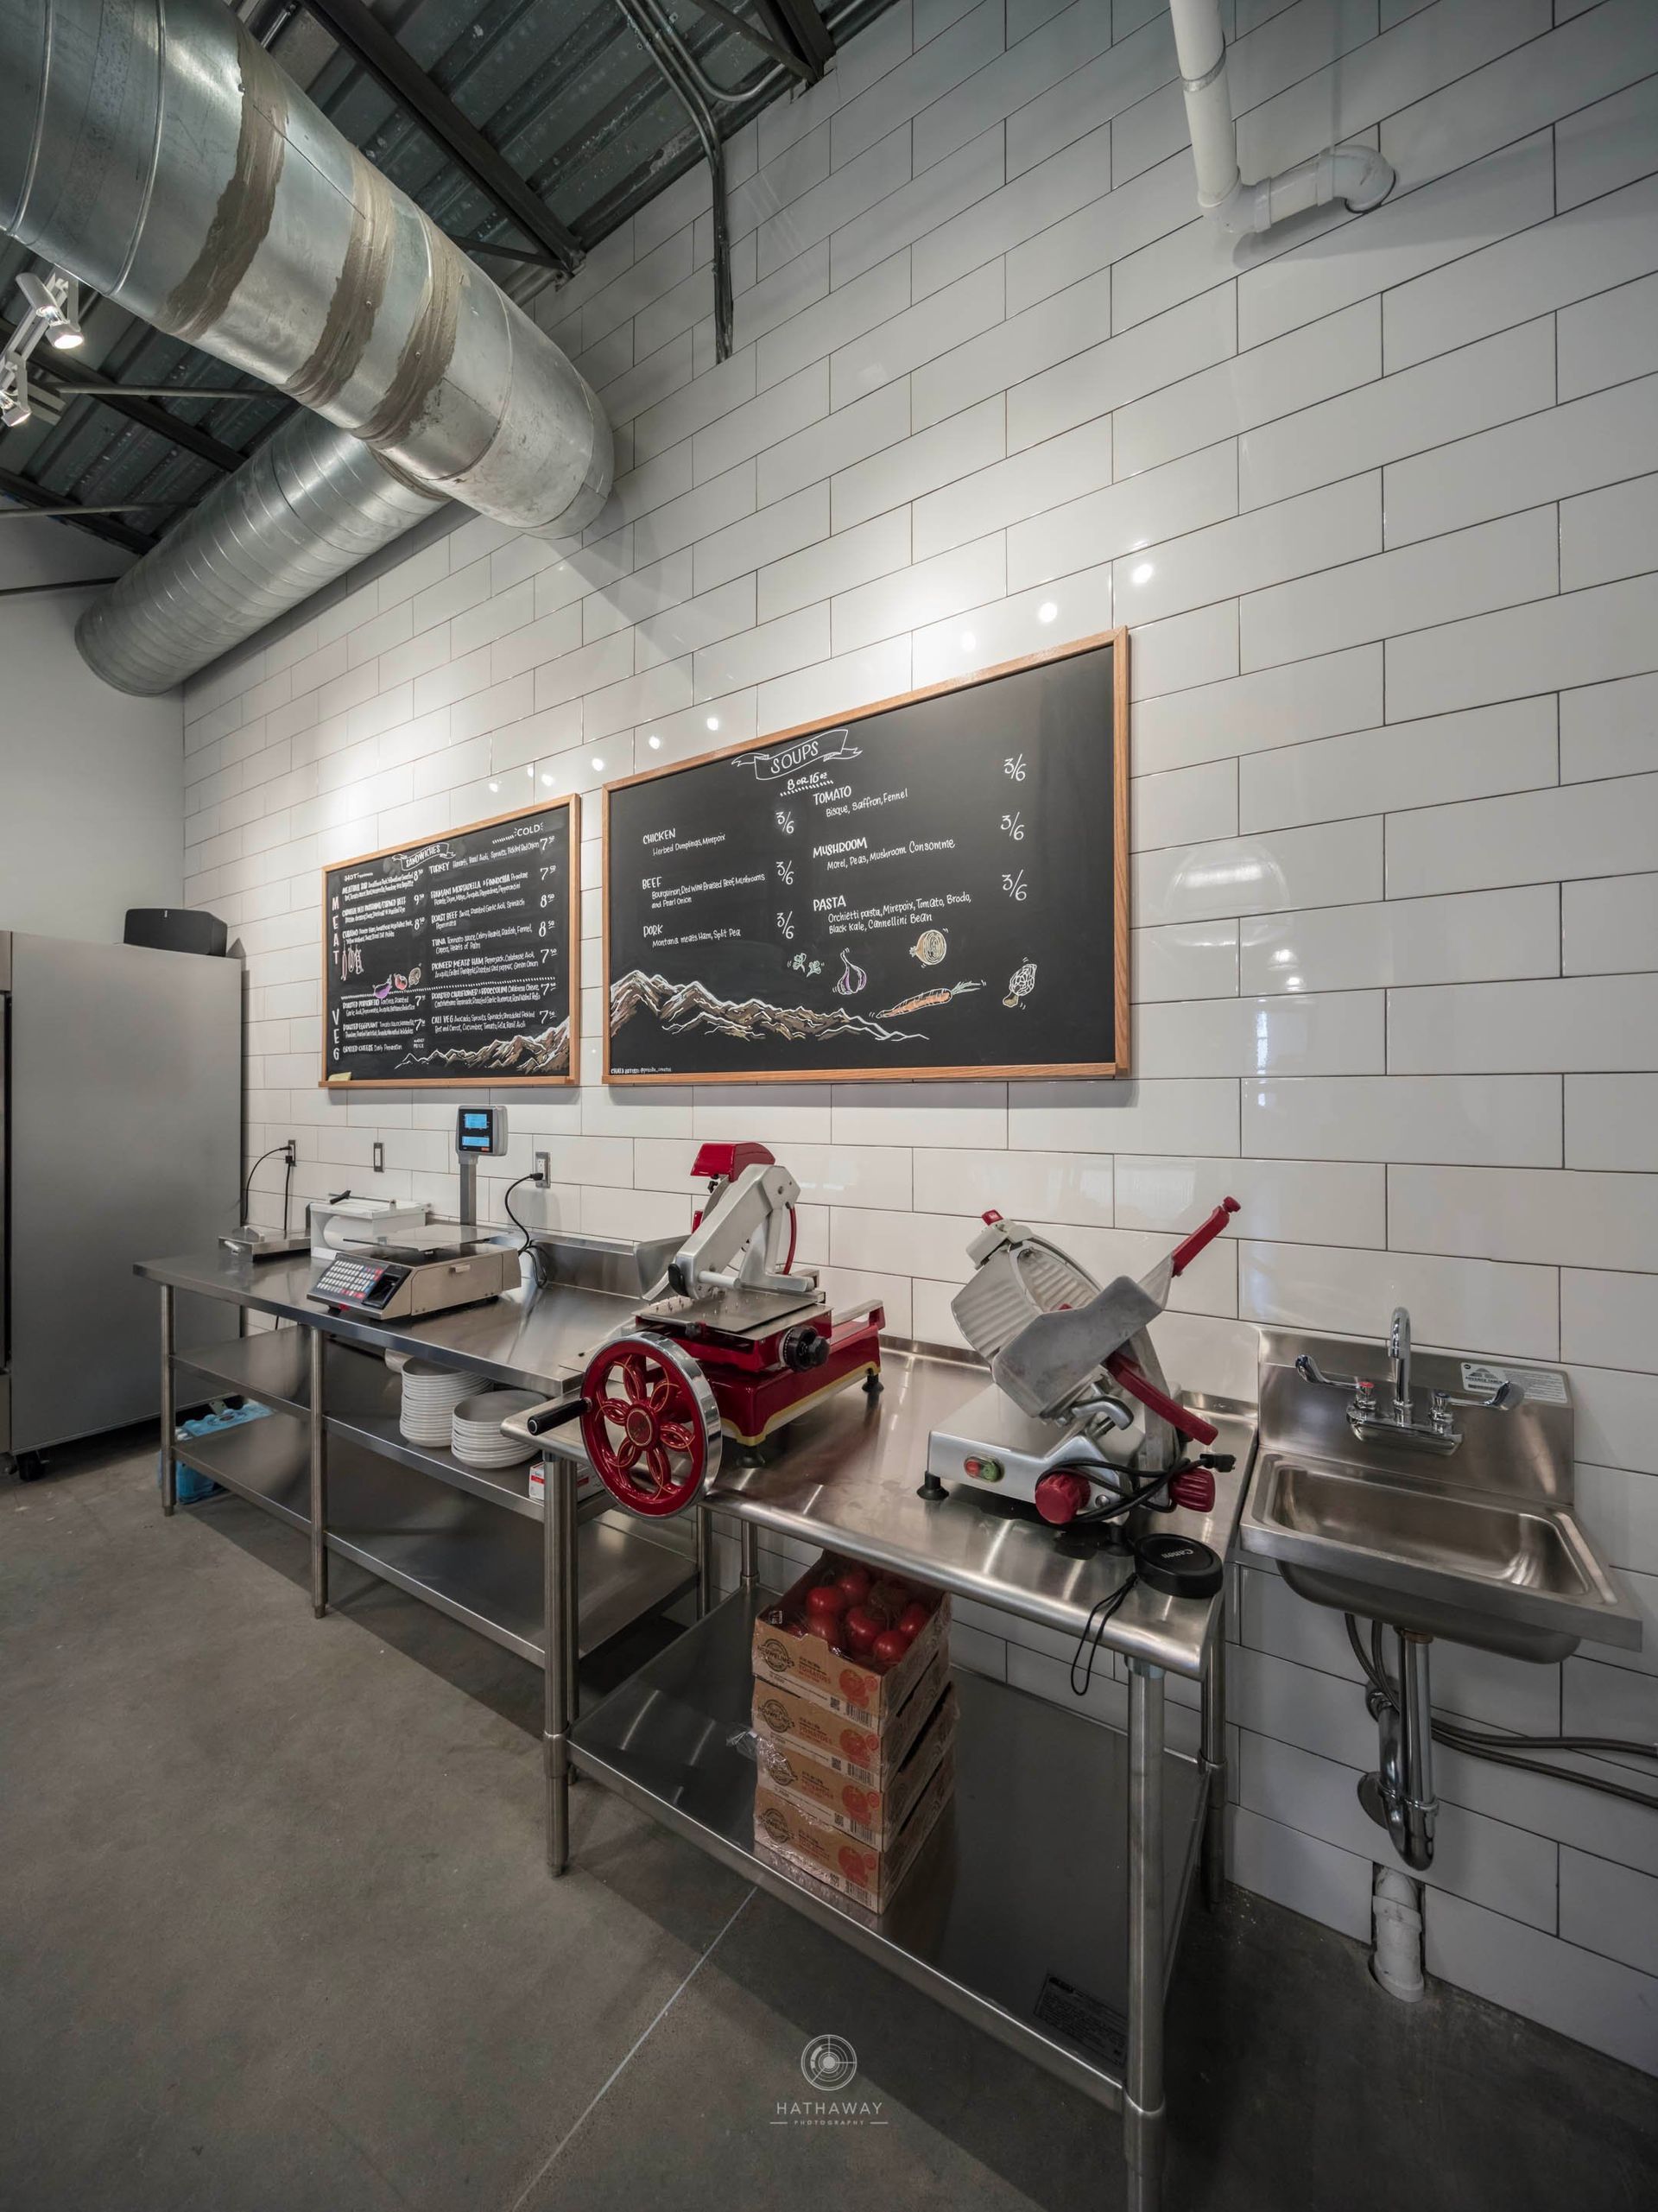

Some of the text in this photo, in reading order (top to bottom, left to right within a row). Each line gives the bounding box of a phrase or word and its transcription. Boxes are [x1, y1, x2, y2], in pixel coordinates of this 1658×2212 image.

[770, 740, 819, 774] SOUPS
[1003, 753, 1027, 782] 3/6
[788, 779, 794, 790] 8
[796, 776, 808, 785] OR
[809, 772, 820, 784] 16
[813, 785, 852, 806] TOMATO
[826, 805, 851, 818] Bisque,
[883, 788, 908, 803] Fennel
[517, 825, 541, 836] COLD
[775, 811, 794, 834] 3/6
[1001, 812, 1025, 840] 3/6
[642, 828, 676, 845] CHICKEN
[653, 833, 726, 856] Herbed Dumplings, Mirepoix
[406, 845, 440, 868] SANDWICHES
[813, 837, 868, 859] MUSHROOM
[827, 839, 956, 871] Morel, Peas, Mushroom Consomme
[428, 861, 450, 874] TURKEY
[776, 860, 794, 885] 3/6
[642, 877, 662, 890] BEEF
[681, 885, 692, 896] Red
[736, 873, 766, 885] Mushrooms
[1002, 869, 1028, 901] 3/6
[652, 896, 692, 909] and Pearl Onion
[813, 895, 846, 911] PASTA
[828, 891, 971, 923] Orchietti pasta, Mirepoix, Tomato, Brodo,
[432, 913, 446, 924] ROAST
[446, 911, 459, 921] BEEF
[777, 911, 795, 939] 3/6
[829, 912, 933, 935] Black Kale, Cannellini Bean
[643, 924, 663, 937] PORK
[653, 937, 679, 948] Montana
[713, 929, 727, 939] Split
[729, 928, 741, 937] Pea
[432, 938, 446, 947] TUNA
[432, 960, 452, 972] PIONEER
[453, 958, 471, 968] MEATS
[471, 957, 484, 966] HAM
[432, 1016, 442, 1024] CALI
[443, 1015, 454, 1024] VEG
[1161, 1550, 1194, 1559] Canon
